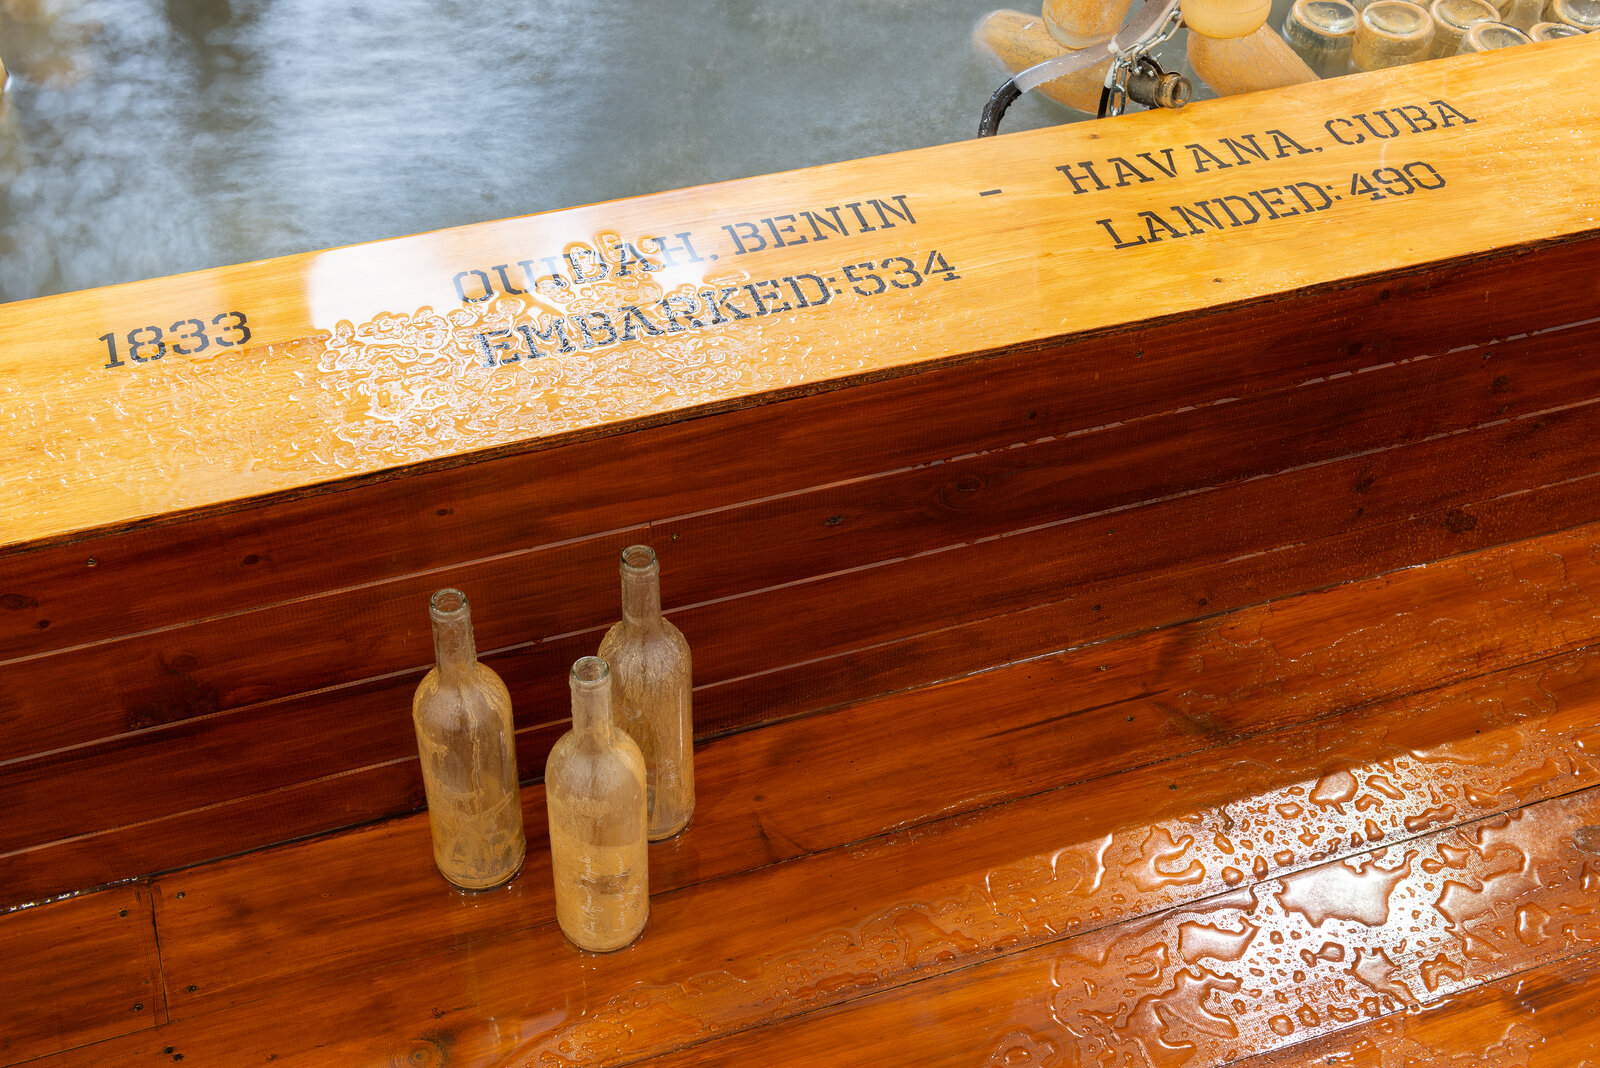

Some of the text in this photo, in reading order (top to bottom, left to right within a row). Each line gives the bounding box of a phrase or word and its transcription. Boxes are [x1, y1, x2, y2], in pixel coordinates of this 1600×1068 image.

[99, 311, 252, 369] 1833
[453, 231, 718, 303] OUIDAH,
[721, 194, 917, 255] BENIN
[1055, 129, 1323, 195] HAVANA,
[1324, 100, 1477, 145] CUBA
